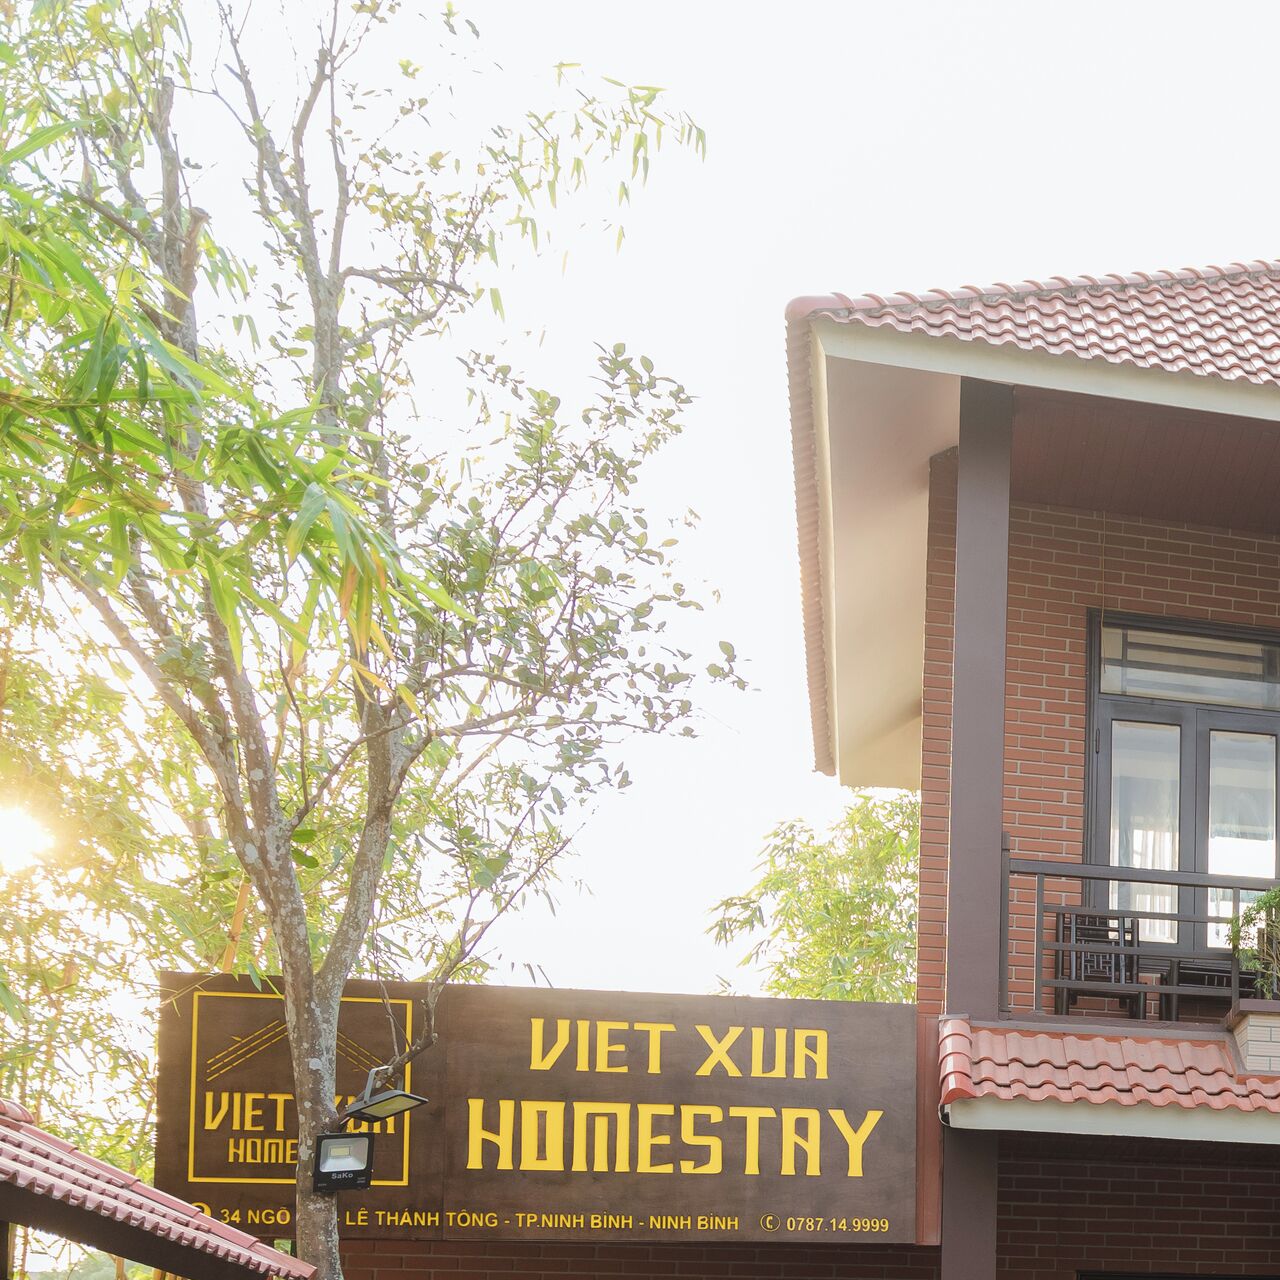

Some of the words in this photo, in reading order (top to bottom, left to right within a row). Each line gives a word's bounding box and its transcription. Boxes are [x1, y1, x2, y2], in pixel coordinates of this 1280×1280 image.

[529, 1016, 677, 1074] VIET
[695, 1023, 829, 1080] XUA
[204, 1091, 295, 1132] VIET
[466, 1097, 882, 1178] HOMESTAY
[220, 1208, 241, 1224] 34
[345, 1207, 369, 1226] LÊ
[375, 1208, 439, 1226] THÁNH
[446, 1209, 498, 1227] TÔNG
[515, 1212, 585, 1229] TP.NINH
[649, 1214, 692, 1230] NINH
[786, 1217, 889, 1232] 0787.14.9999
